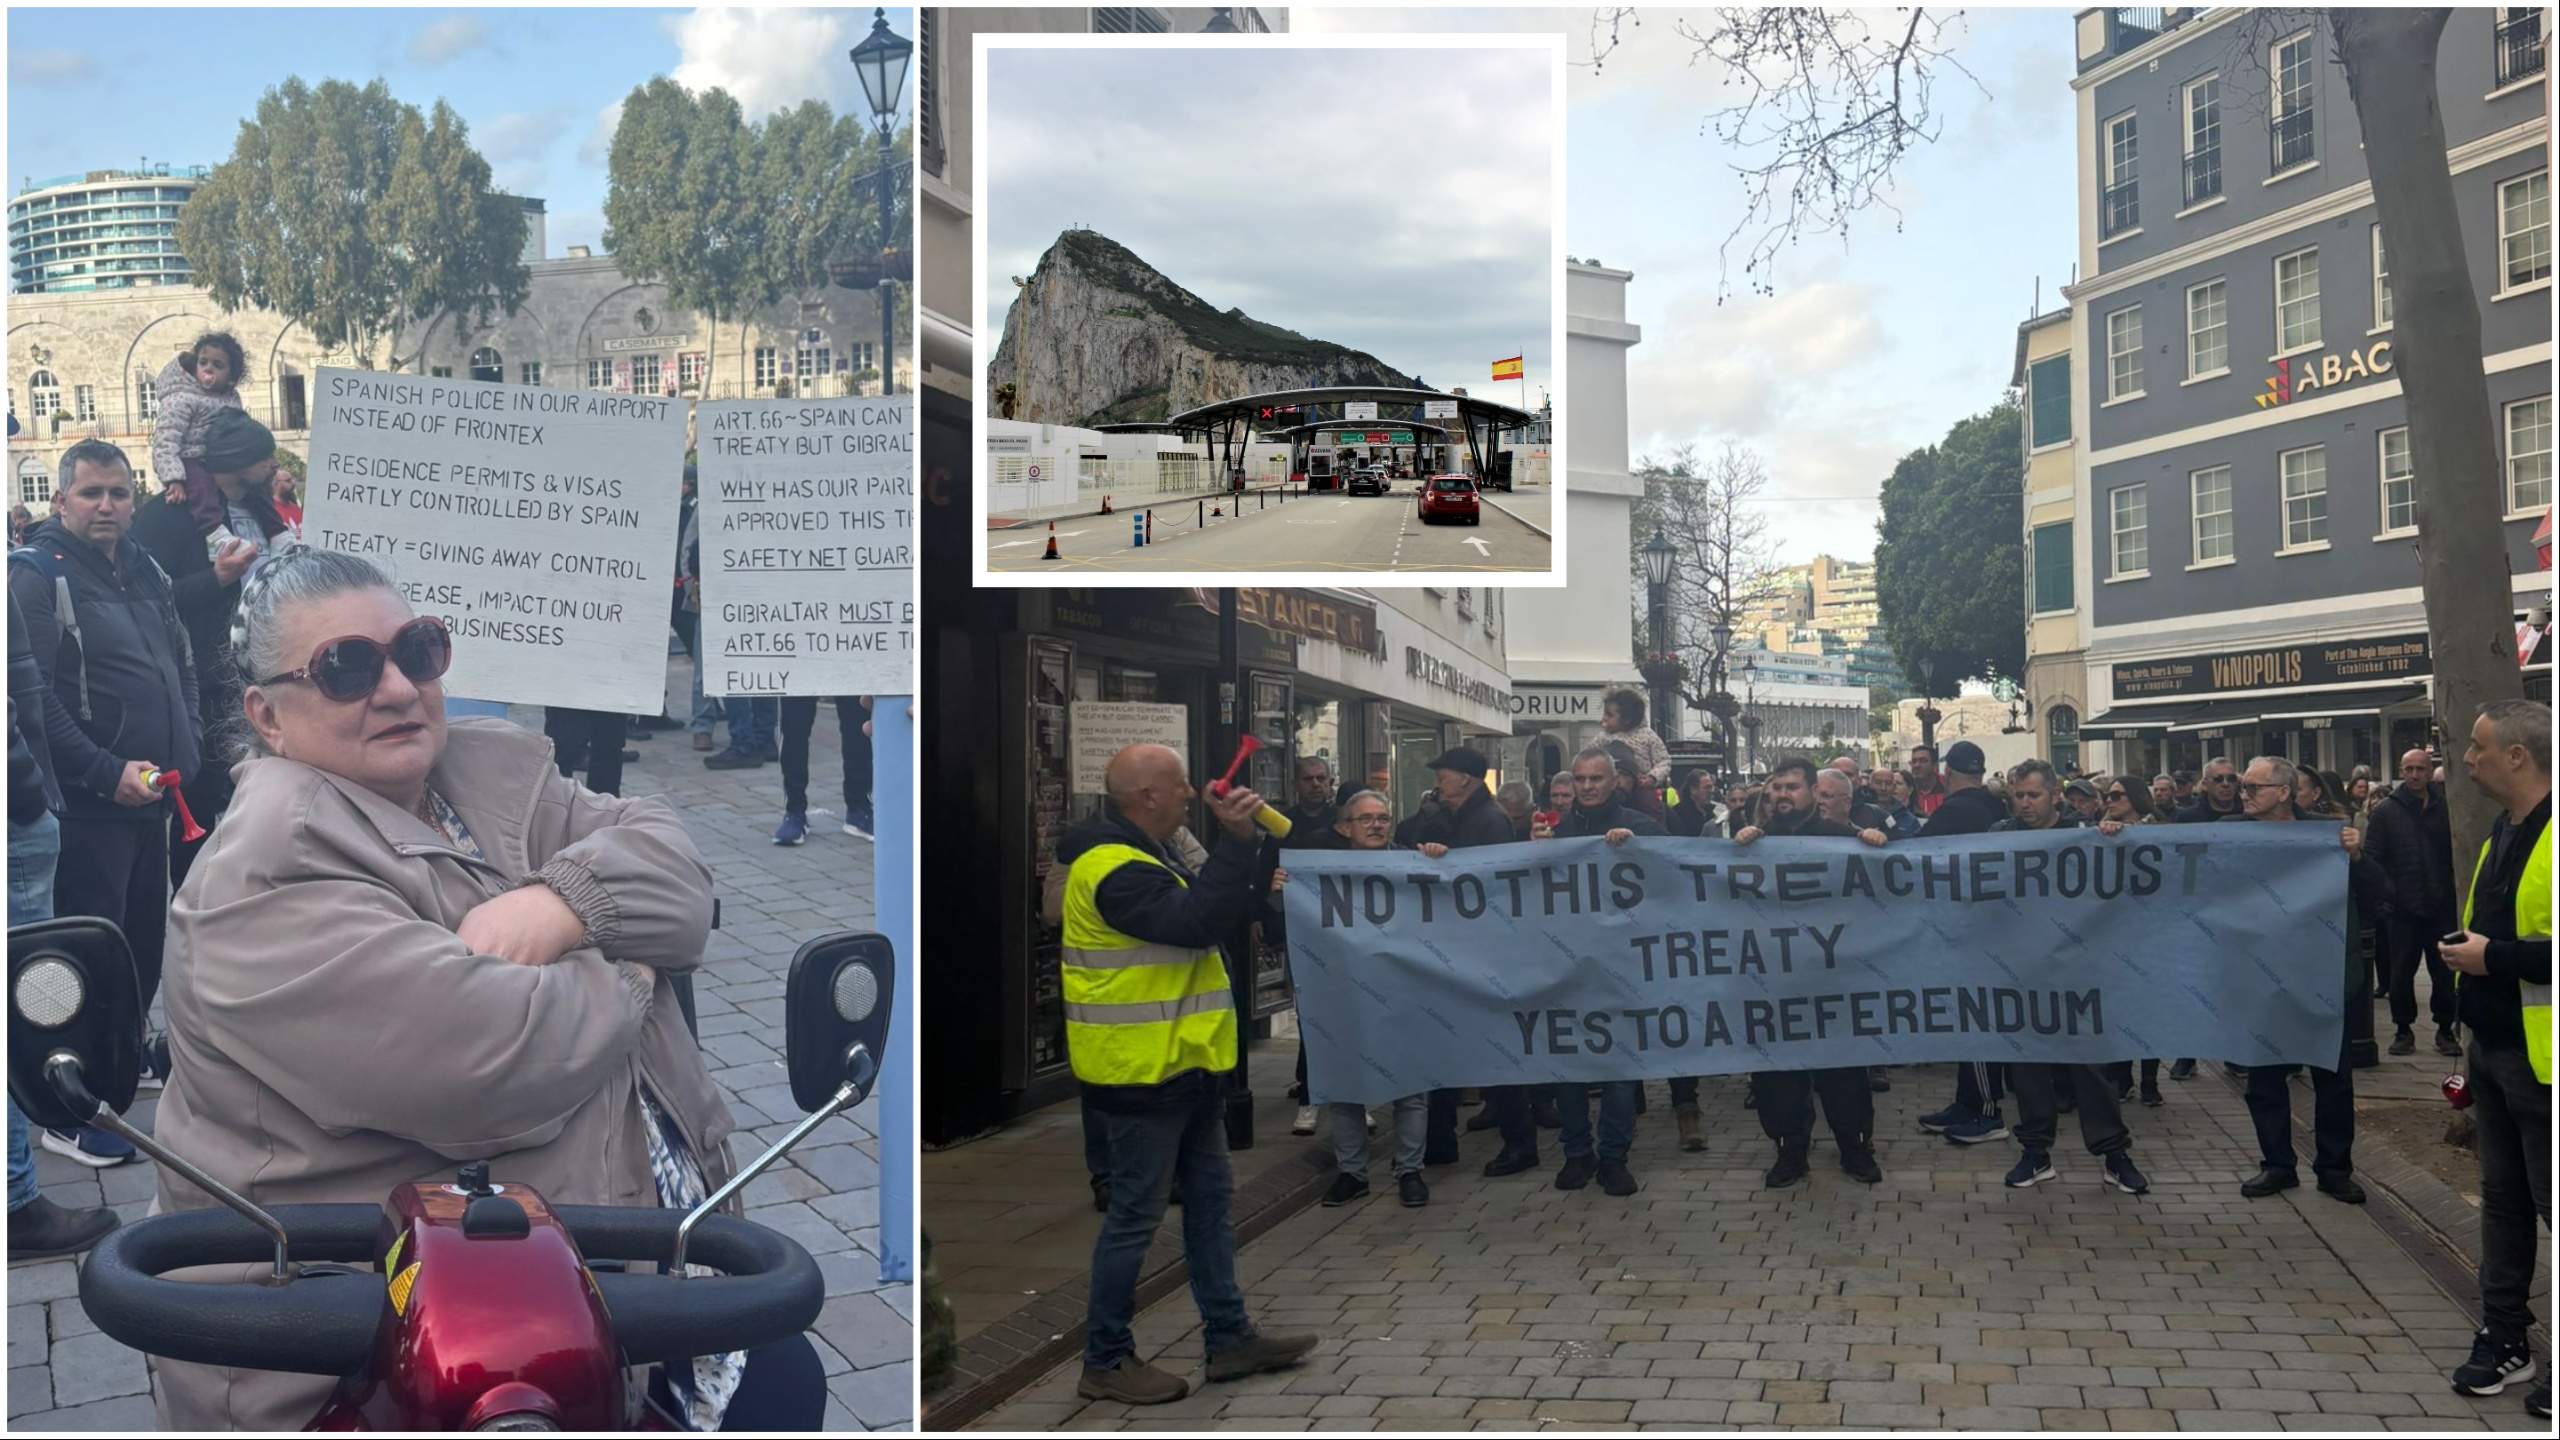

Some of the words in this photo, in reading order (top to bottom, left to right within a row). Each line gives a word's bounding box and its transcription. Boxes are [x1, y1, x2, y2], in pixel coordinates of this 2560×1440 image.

[609, 336, 680, 350] CASEMATES
[2296, 341, 2392, 393] ABAC
[331, 377, 423, 405] SPANISH
[432, 388, 505, 411] POLICE
[513, 392, 534, 411] IN
[540, 393, 580, 414] OUR
[586, 397, 670, 421] AIRPORT
[333, 406, 416, 431] INSTEAD
[421, 415, 447, 434] OF
[455, 417, 544, 445] FRONTEX
[861, 407, 902, 427] CAN
[713, 436, 790, 456] TREATY
[796, 435, 833, 456] BUT
[843, 433, 914, 454] GIBRAL
[328, 453, 442, 482] RESIDENCE
[450, 465, 536, 492] PERMITS
[543, 474, 558, 493] &
[564, 475, 622, 499] VISAS
[720, 480, 766, 499] WHY
[773, 479, 814, 499] HAS
[818, 478, 858, 497] OUR
[327, 483, 402, 507] PARTLY
[409, 490, 542, 519] CONTROLLED
[548, 502, 574, 522] BY
[581, 505, 639, 529] SPAIN
[723, 511, 829, 531] APPROVED
[839, 510, 885, 530] THIS
[322, 530, 398, 555] TREATY
[491, 548, 542, 569] AWAY
[551, 553, 647, 581] CONTROL
[723, 548, 802, 568] SAFETY
[809, 547, 847, 567] NET
[479, 590, 548, 616] IMPACT
[551, 599, 577, 619] ON
[582, 601, 623, 623] OUR
[723, 601, 828, 624] GIBRALTAR
[839, 601, 893, 622] MUST
[443, 615, 564, 646] BUSINESSES
[805, 632, 830, 652] TO
[836, 632, 888, 651] HAVE
[727, 671, 790, 691] FULLY
[2212, 650, 2301, 688] VINOPOLIS
[2337, 661, 2383, 675] Established
[1511, 695, 1588, 714] ORIUM
[1319, 874, 1395, 928] NO
[1406, 873, 1486, 922] TO
[1494, 862, 1646, 917] THIS
[1630, 924, 1845, 982] TREATY
[1513, 1010, 1613, 1055] YES
[1622, 1005, 1689, 1051] TO
[1704, 1001, 1733, 1047] A
[1744, 986, 2103, 1045] REFERENDUM
